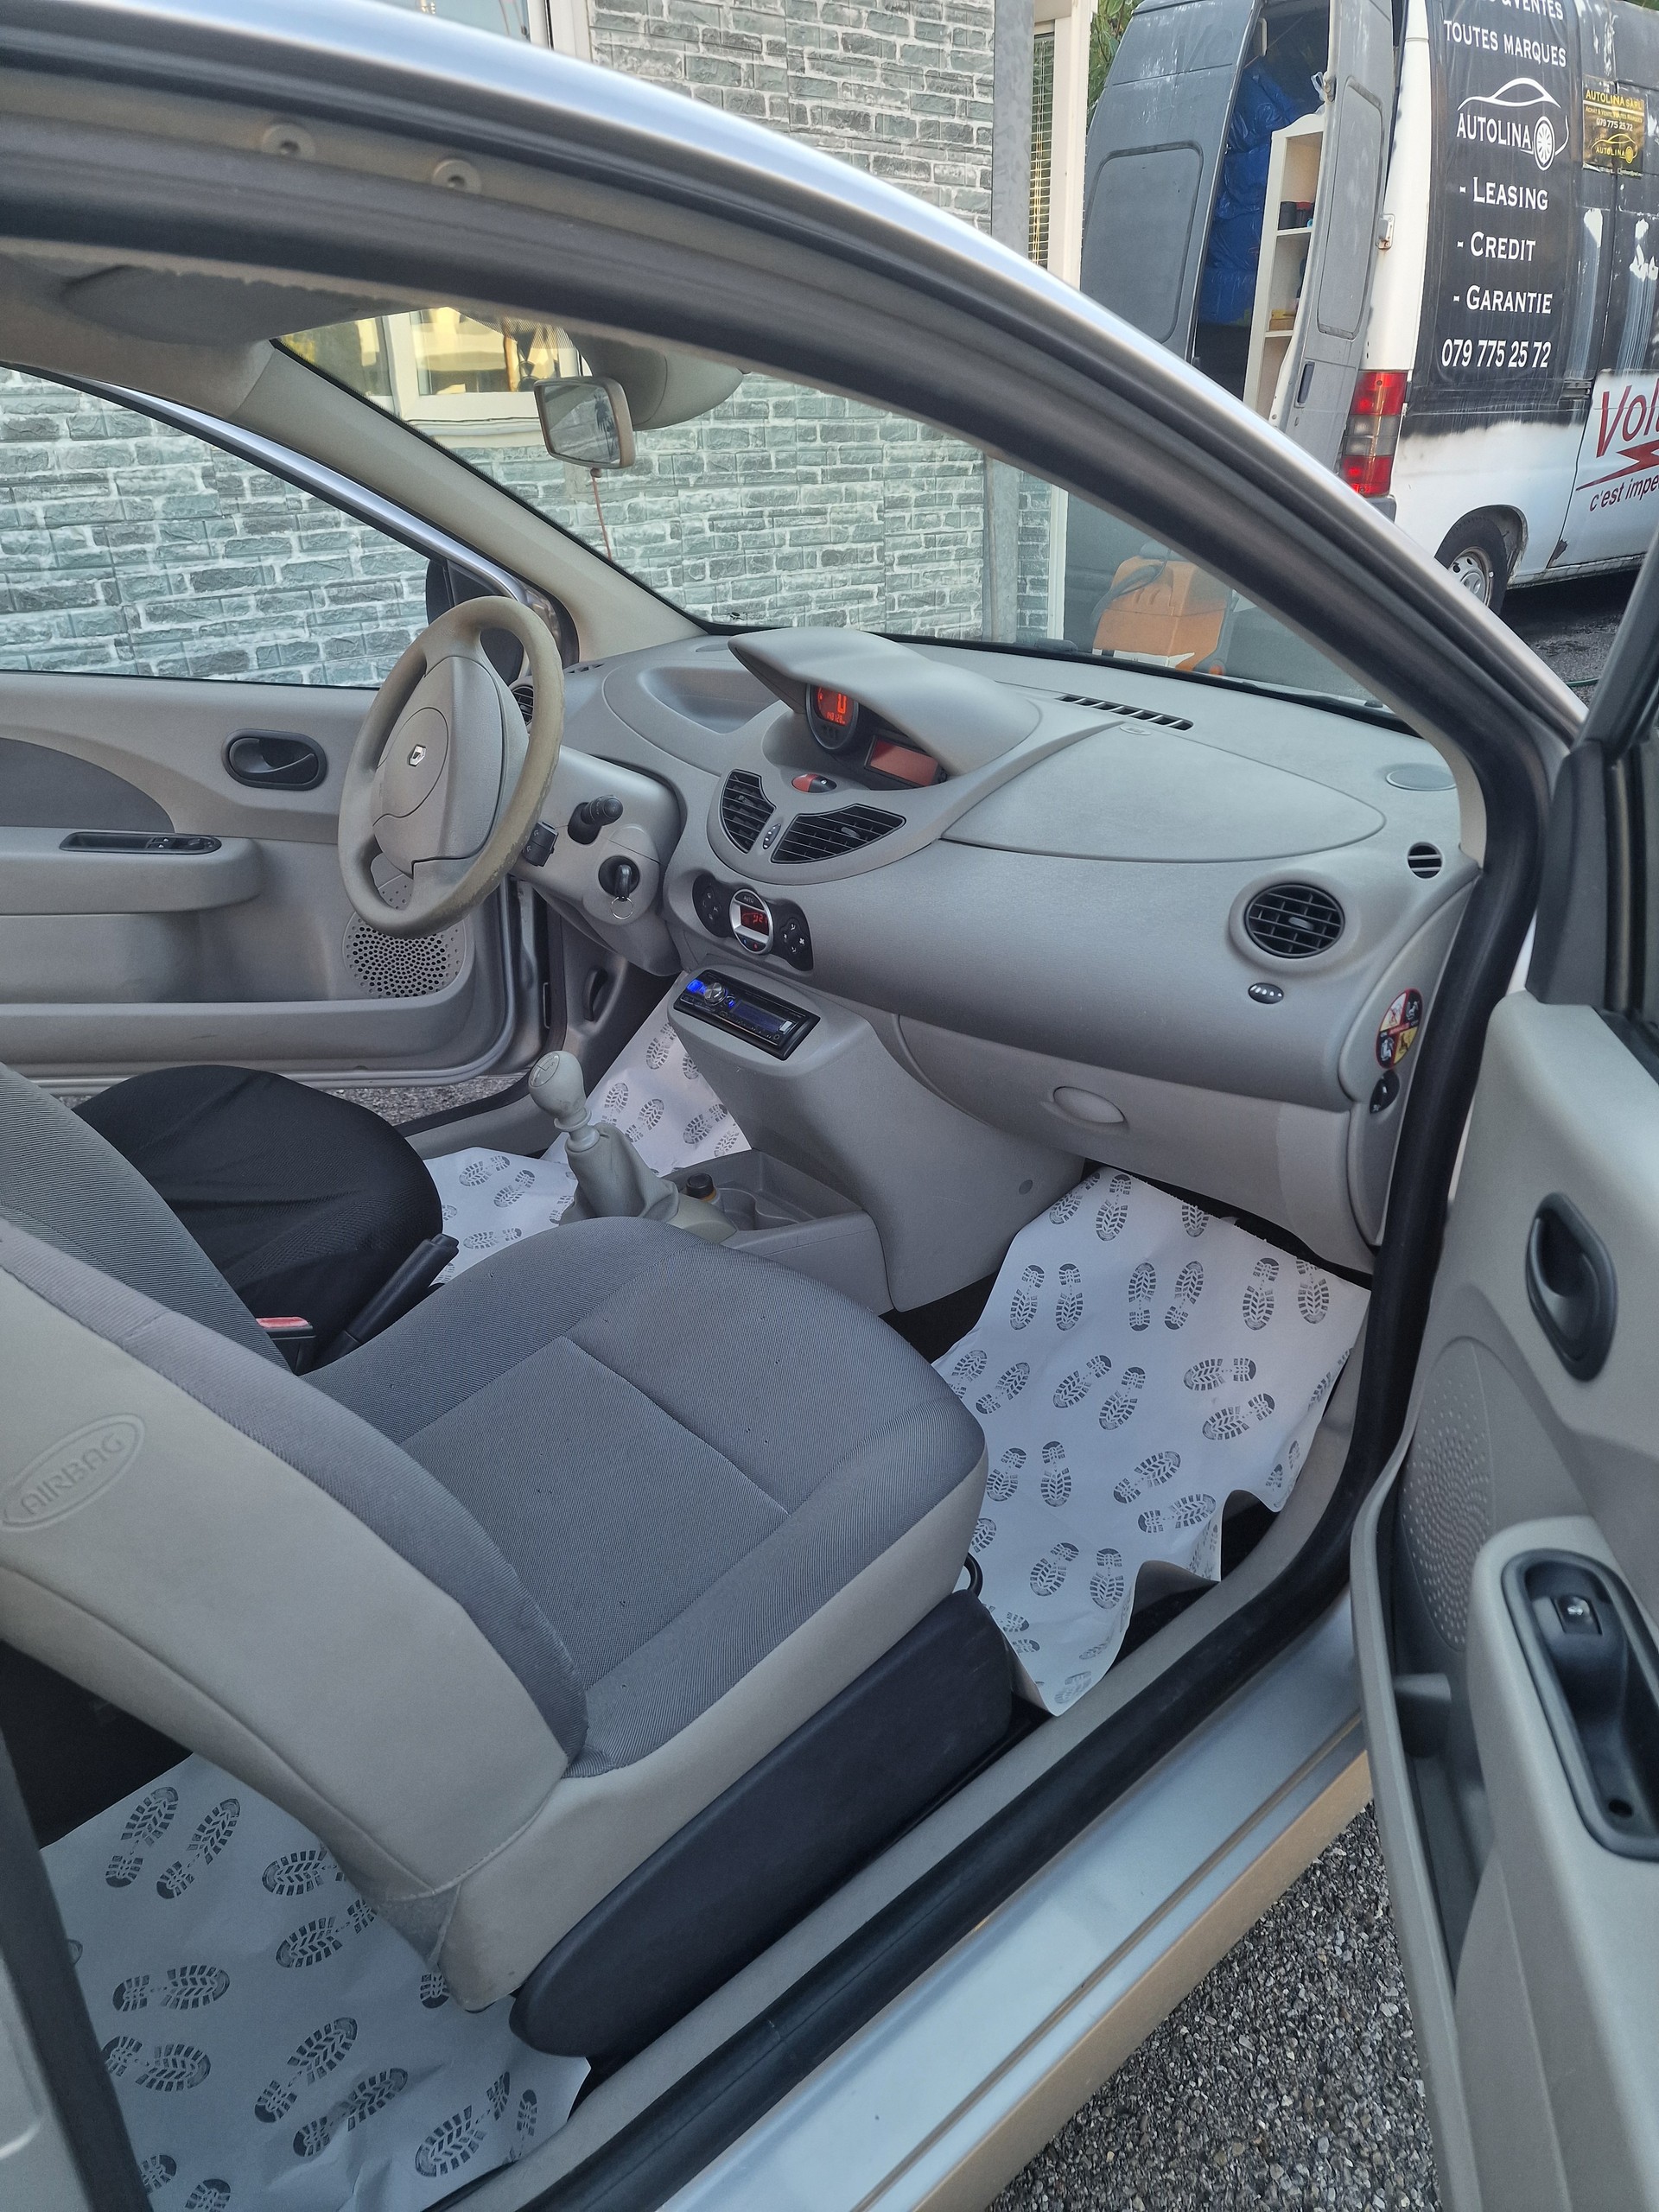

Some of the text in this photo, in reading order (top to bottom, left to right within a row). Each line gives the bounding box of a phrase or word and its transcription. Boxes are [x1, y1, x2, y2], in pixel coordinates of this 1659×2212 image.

[1444, 20, 1567, 67] TOUTES MARQUES
[1586, 89, 1624, 107] AUTOLINA
[1457, 113, 1533, 150] AUTOLINA
[1607, 119, 1618, 129] 775
[1596, 146, 1624, 156] AUTOLINA
[1472, 176, 1548, 210] LEASING
[1471, 231, 1536, 262] CREDIT
[1466, 284, 1553, 315] GARANTIE
[1441, 339, 1552, 368] 079 775 25 72
[1596, 378, 1659, 458] Vol
[1589, 481, 1625, 512] c'est
[743, 895, 754, 904] AUTO
[21, 1433, 124, 1515] AIRBAG
